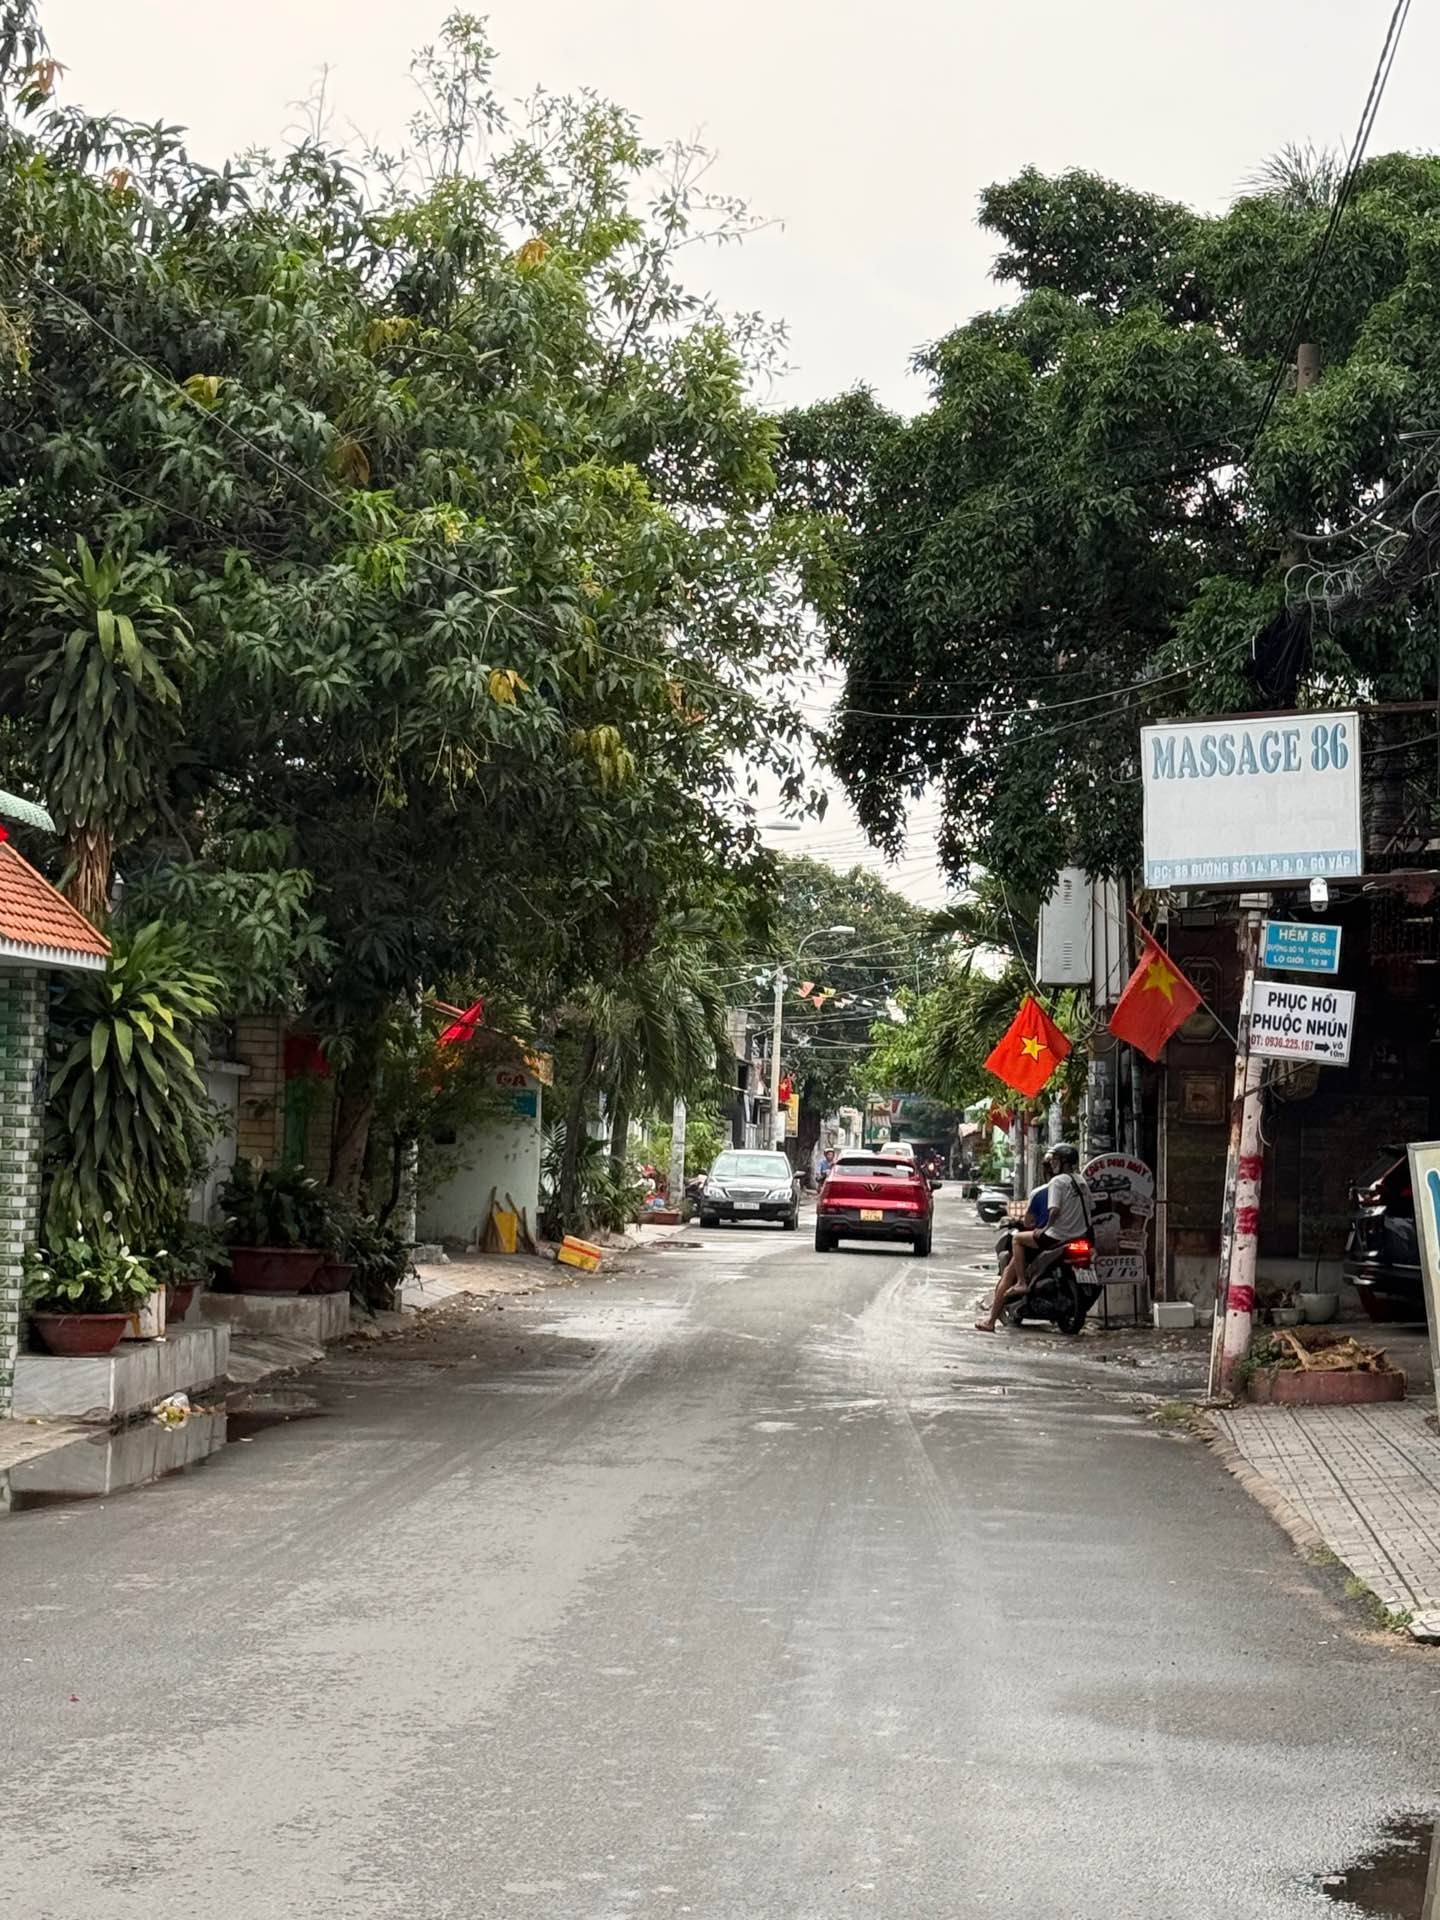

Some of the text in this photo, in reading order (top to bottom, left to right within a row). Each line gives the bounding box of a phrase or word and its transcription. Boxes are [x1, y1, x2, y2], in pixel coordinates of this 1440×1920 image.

[1152, 722, 1349, 779] MASSAGE 86
[1232, 857, 1247, 874] SỐ
[1270, 859, 1279, 872] P.
[1310, 855, 1325, 872] GÒ
[1328, 851, 1351, 871] VẤP
[1311, 932, 1327, 943] 86
[1267, 991, 1337, 1014] PHỤC HỒI
[1252, 1013, 1348, 1038] PHUỘC NHÚN
[1099, 1257, 1136, 1267] COFFEE
